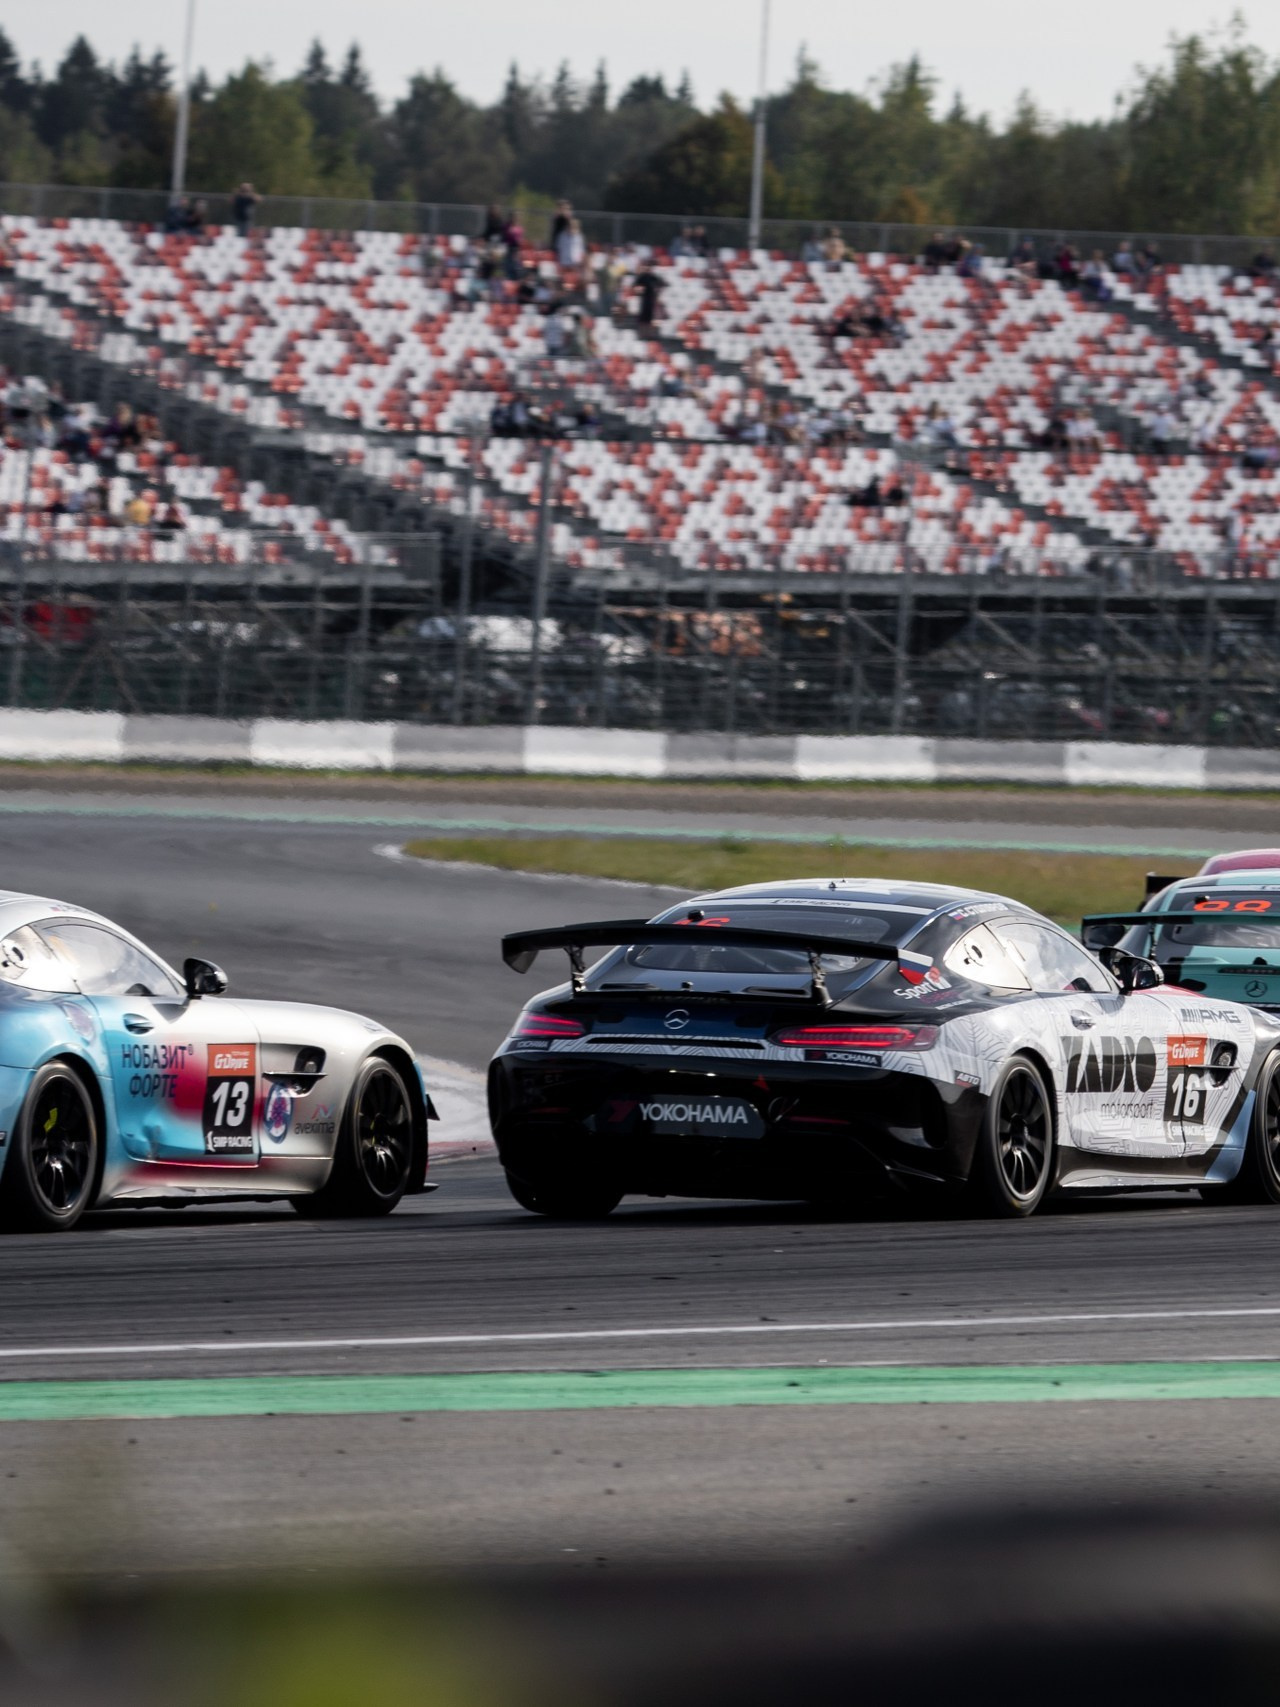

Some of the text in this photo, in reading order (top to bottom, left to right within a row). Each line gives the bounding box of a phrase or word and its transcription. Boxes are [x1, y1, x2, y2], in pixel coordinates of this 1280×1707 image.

[825, 1051, 877, 1065] YOKOHAMA
[129, 1073, 178, 1099] ФОРТЕ
[1172, 1073, 1200, 1118] 16
[212, 1081, 249, 1127] 13
[639, 1102, 748, 1125] YOKOHAMA
[1100, 1101, 1156, 1119] motorsport
[294, 1119, 335, 1134] avexima
[213, 1136, 252, 1148] SMP RACING
